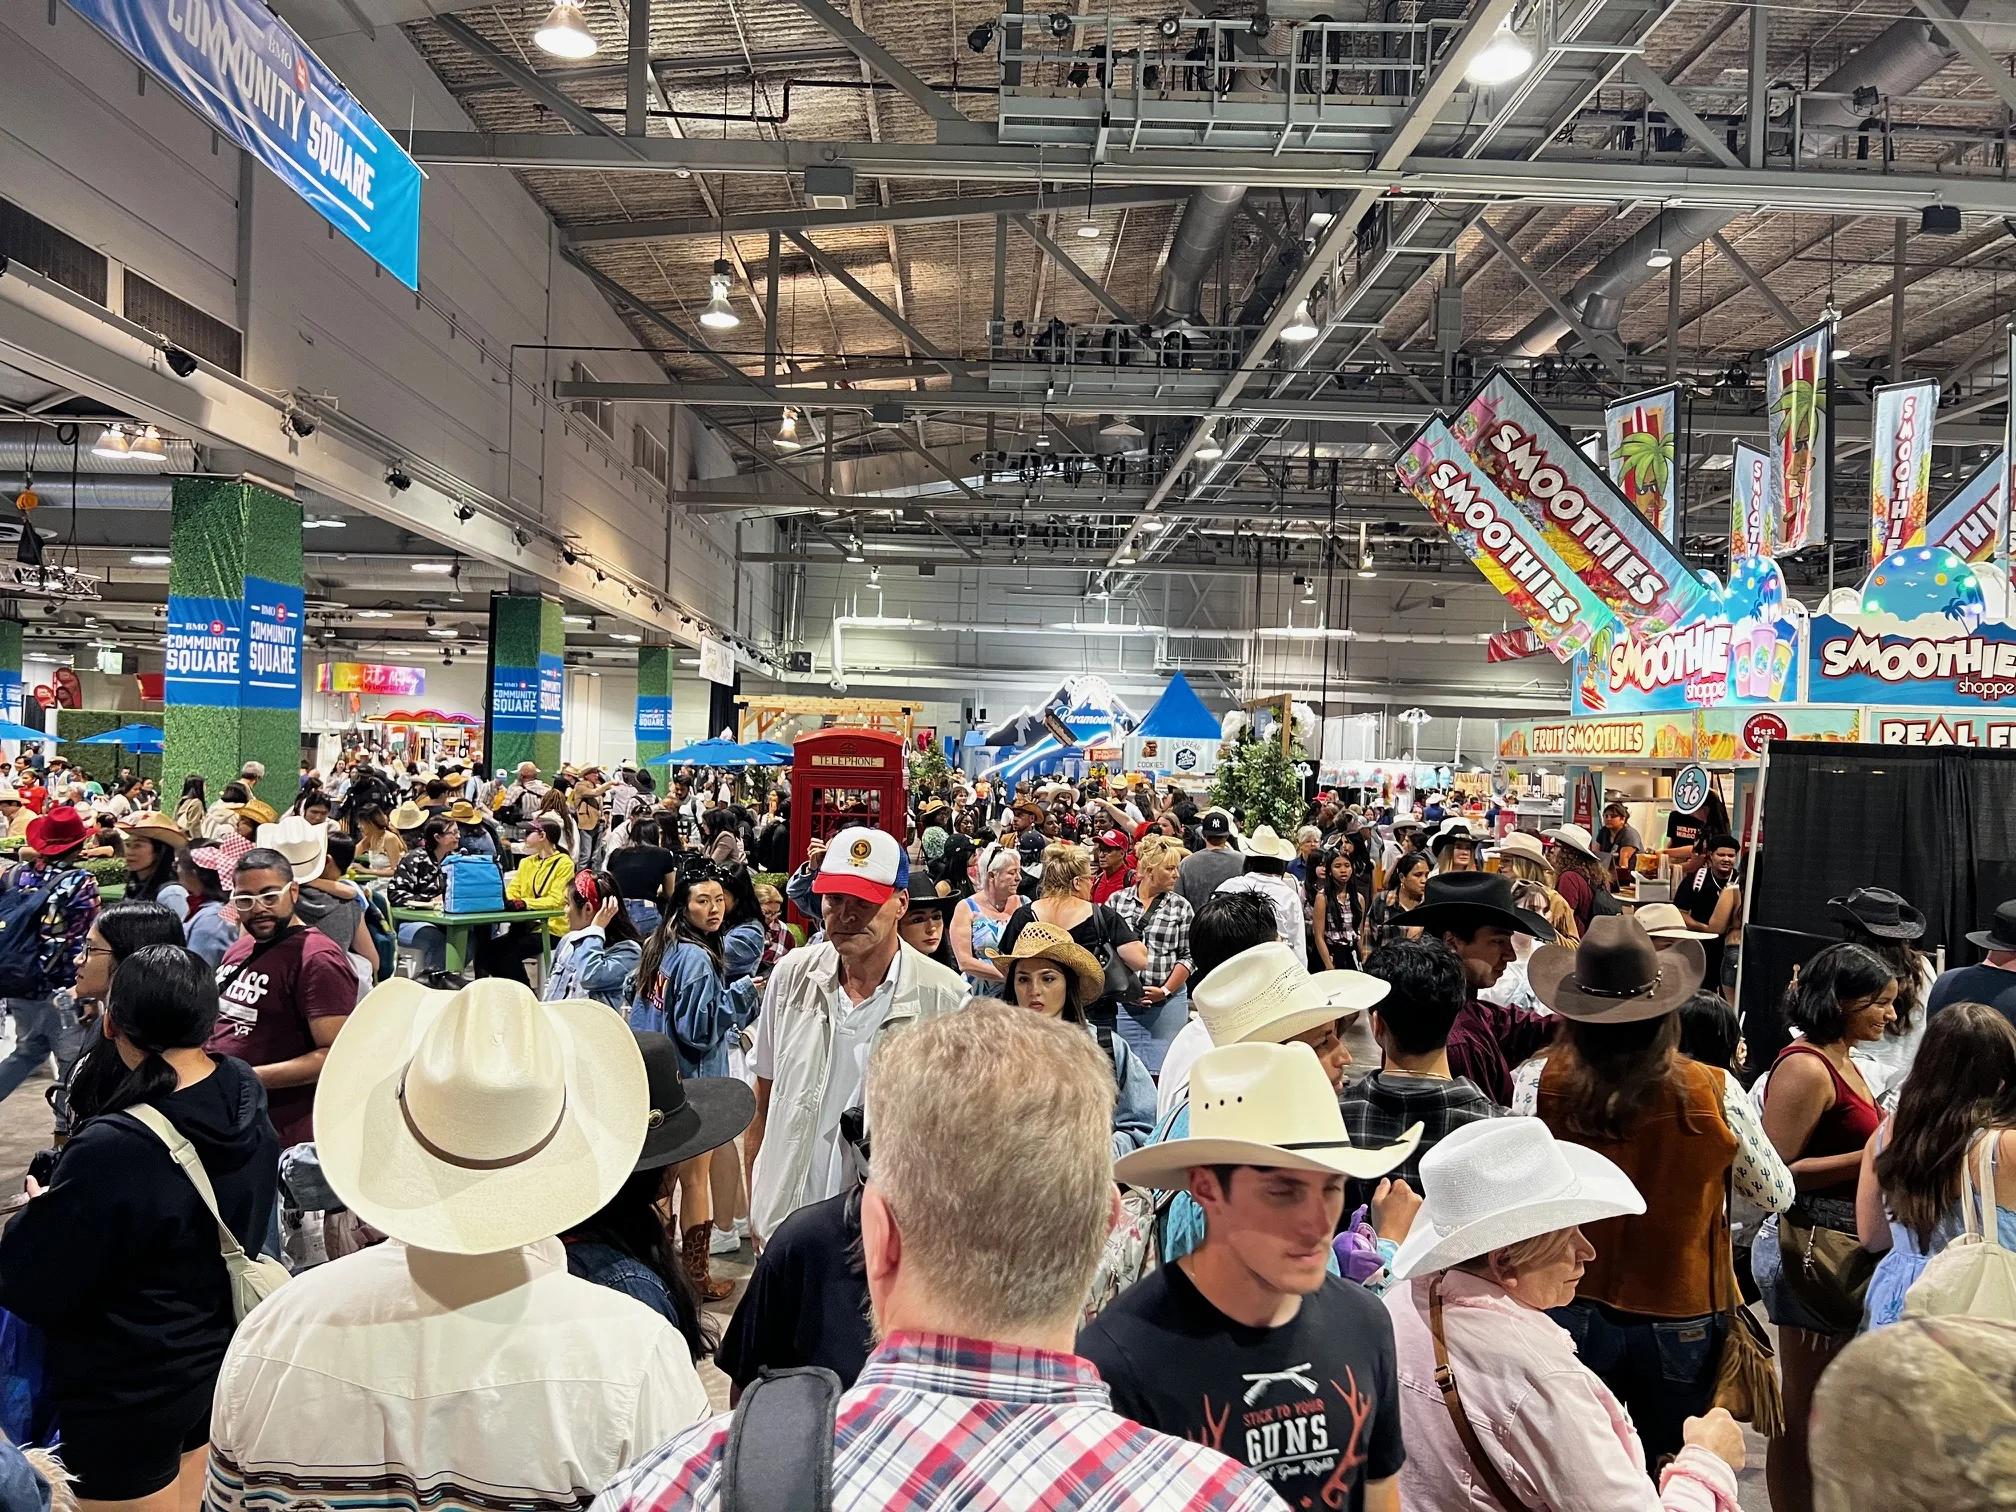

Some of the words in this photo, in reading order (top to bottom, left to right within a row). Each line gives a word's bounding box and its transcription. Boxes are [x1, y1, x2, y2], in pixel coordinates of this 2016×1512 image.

[268, 38, 292, 70] BMO
[167, 0, 306, 142] COMMUNITY
[306, 110, 375, 210] SQUARE
[1489, 423, 1665, 606] SMOOTHIES
[1429, 463, 1579, 625] SMOOTHIES
[261, 604, 276, 616] BMO
[185, 622, 208, 632] BMO
[250, 620, 297, 645] COMMUNITY
[167, 634, 241, 652] COMMUNITY
[166, 648, 240, 674] SQUARE
[249, 641, 297, 675] SQUARE
[1609, 623, 1732, 692] SMOOTHIE
[1822, 632, 2016, 681] SMOOTHIE
[493, 689, 538, 699] COMMUNITY
[1686, 681, 1726, 706] shoppe
[1958, 676, 2015, 699] shoppe
[493, 698, 537, 714] SQUARE
[1532, 726, 1564, 752] FRUIT
[1567, 723, 1643, 753] SMOOTHIES
[1753, 726, 1776, 735] Best
[1883, 721, 1977, 747] REAL
[818, 756, 877, 767] TELEPHONE
[1137, 761, 1165, 769] COOKIES
[1687, 771, 1695, 783] 2
[1678, 785, 1700, 805] $16
[1245, 1413, 1328, 1466] GUNS
